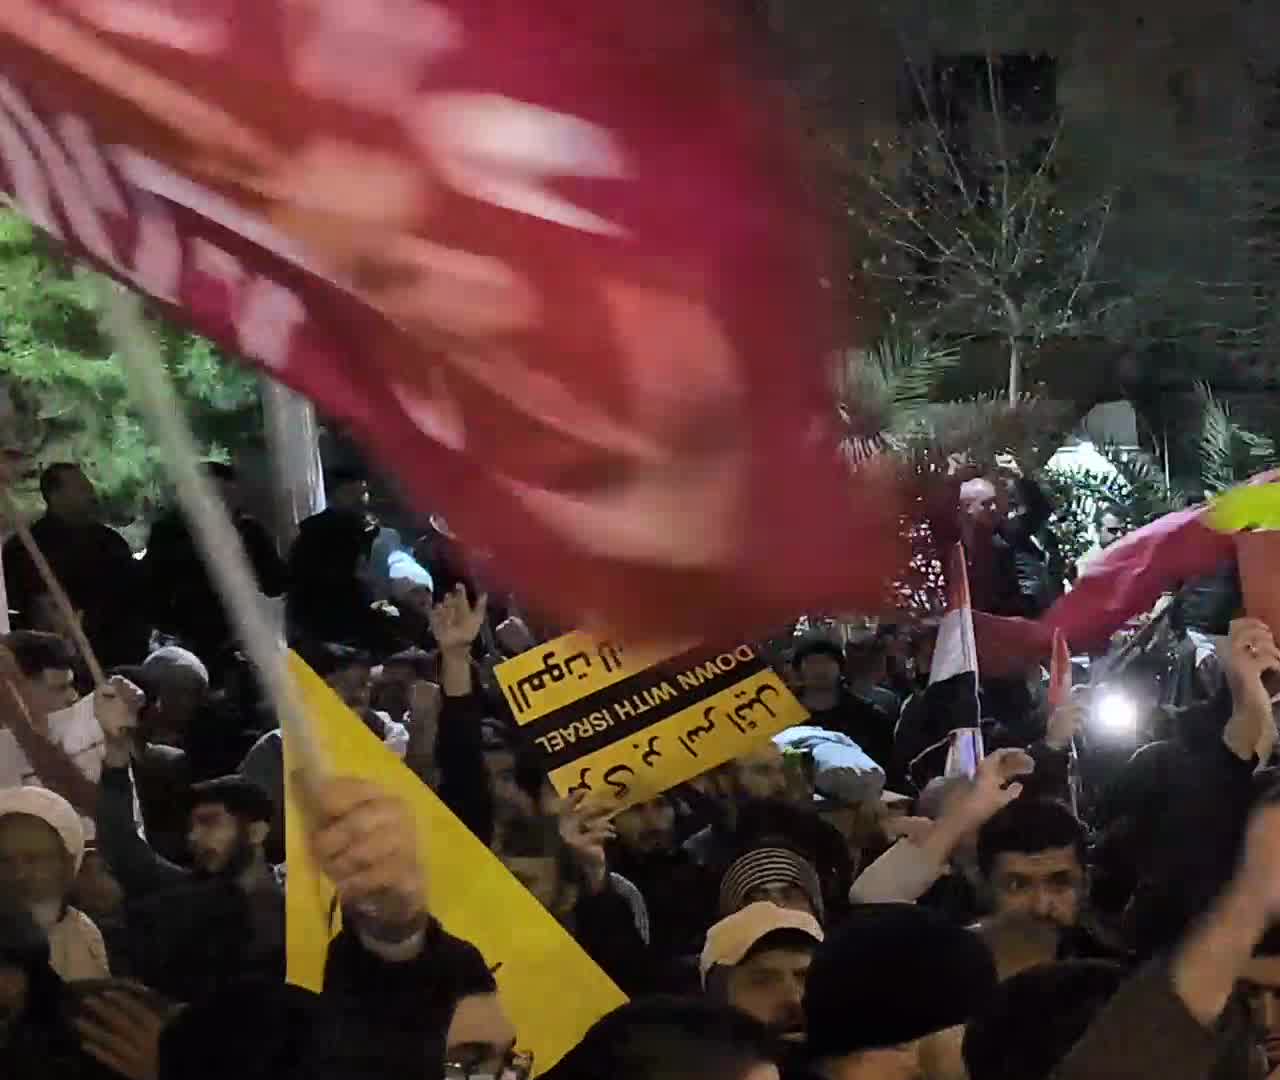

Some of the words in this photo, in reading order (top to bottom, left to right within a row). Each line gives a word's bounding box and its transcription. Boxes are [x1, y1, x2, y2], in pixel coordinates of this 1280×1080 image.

[507, 651, 591, 713] الموت
[679, 643, 756, 689] DOWN
[614, 682, 677, 721] WITH
[535, 710, 616, 753] ISRAEL
[632, 735, 663, 767] بر
